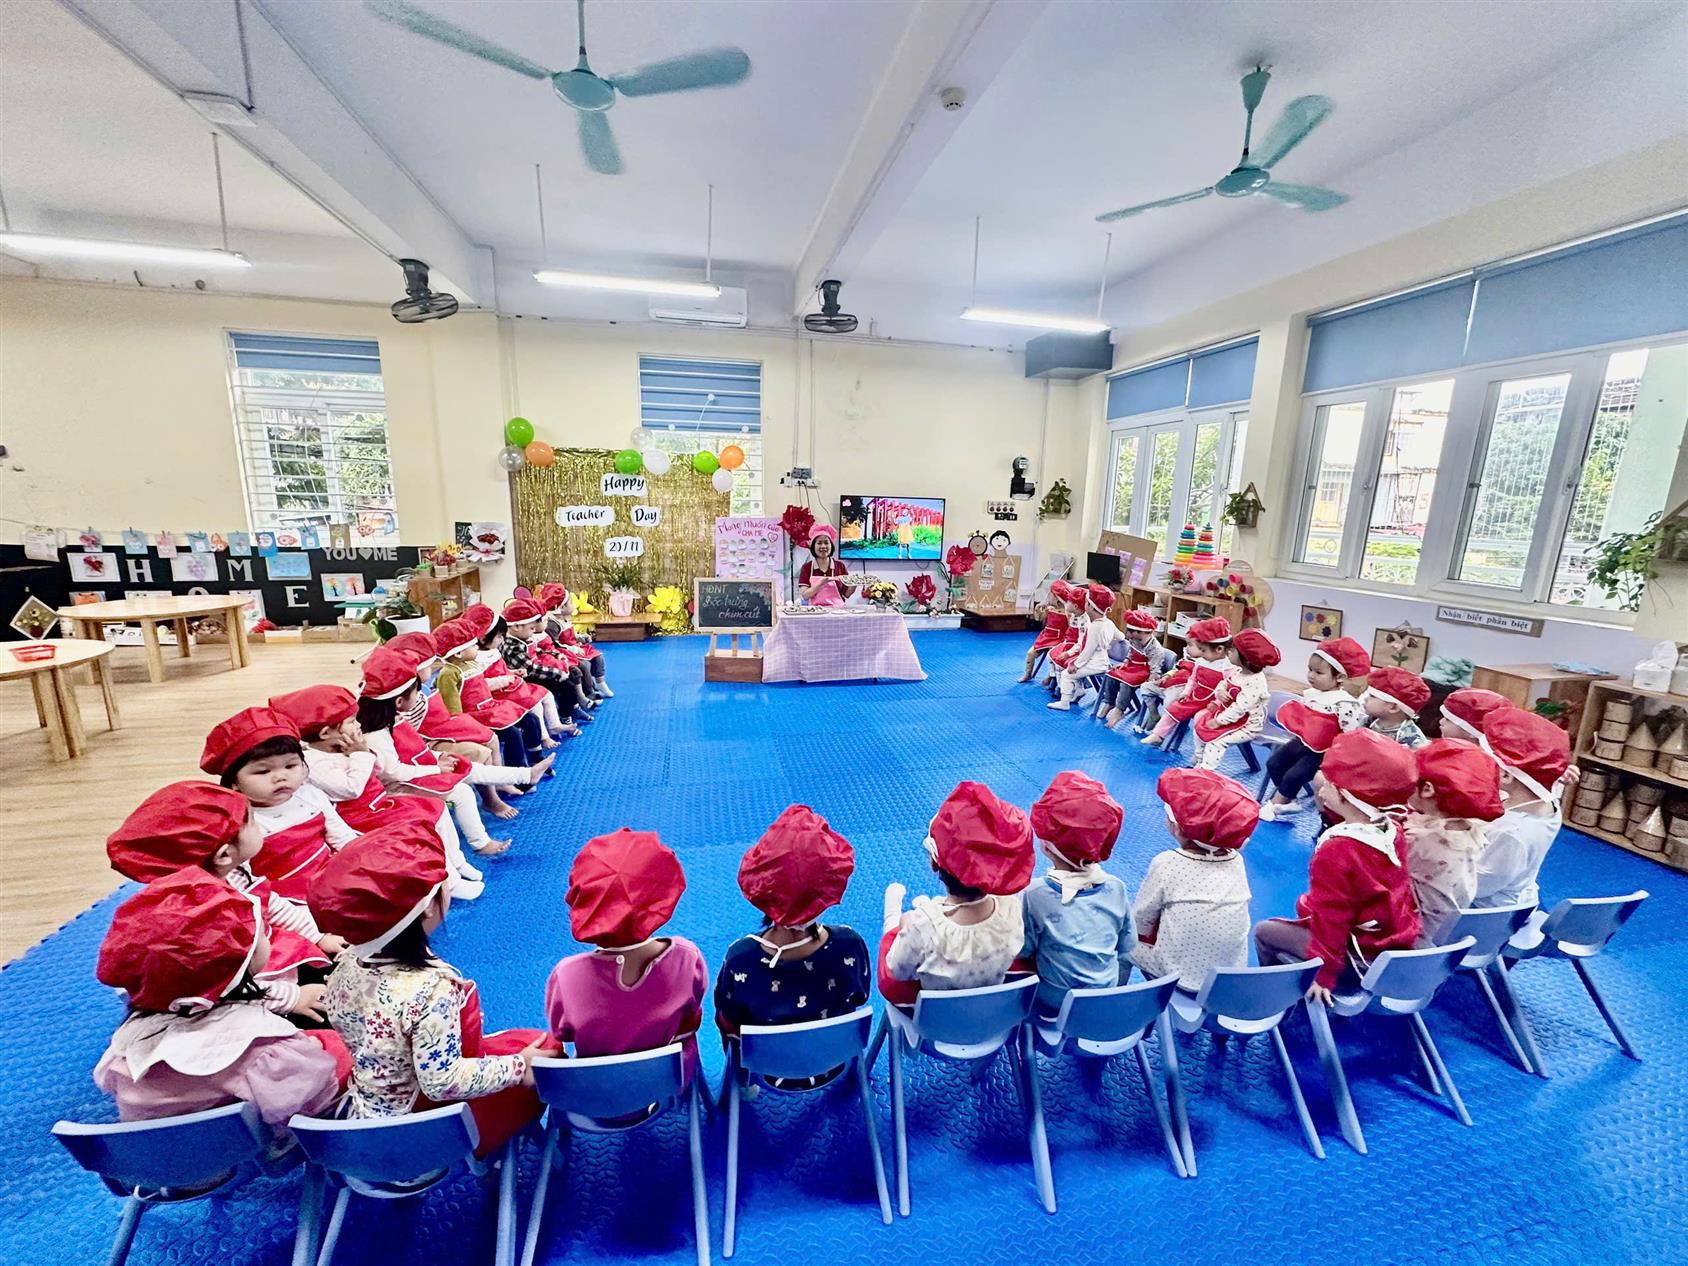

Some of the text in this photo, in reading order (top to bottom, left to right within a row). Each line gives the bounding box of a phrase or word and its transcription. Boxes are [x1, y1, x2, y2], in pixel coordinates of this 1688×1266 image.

[604, 476, 645, 491] Happy
[566, 508, 657, 524] Teacher Day
[322, 547, 398, 560] YOU ME
